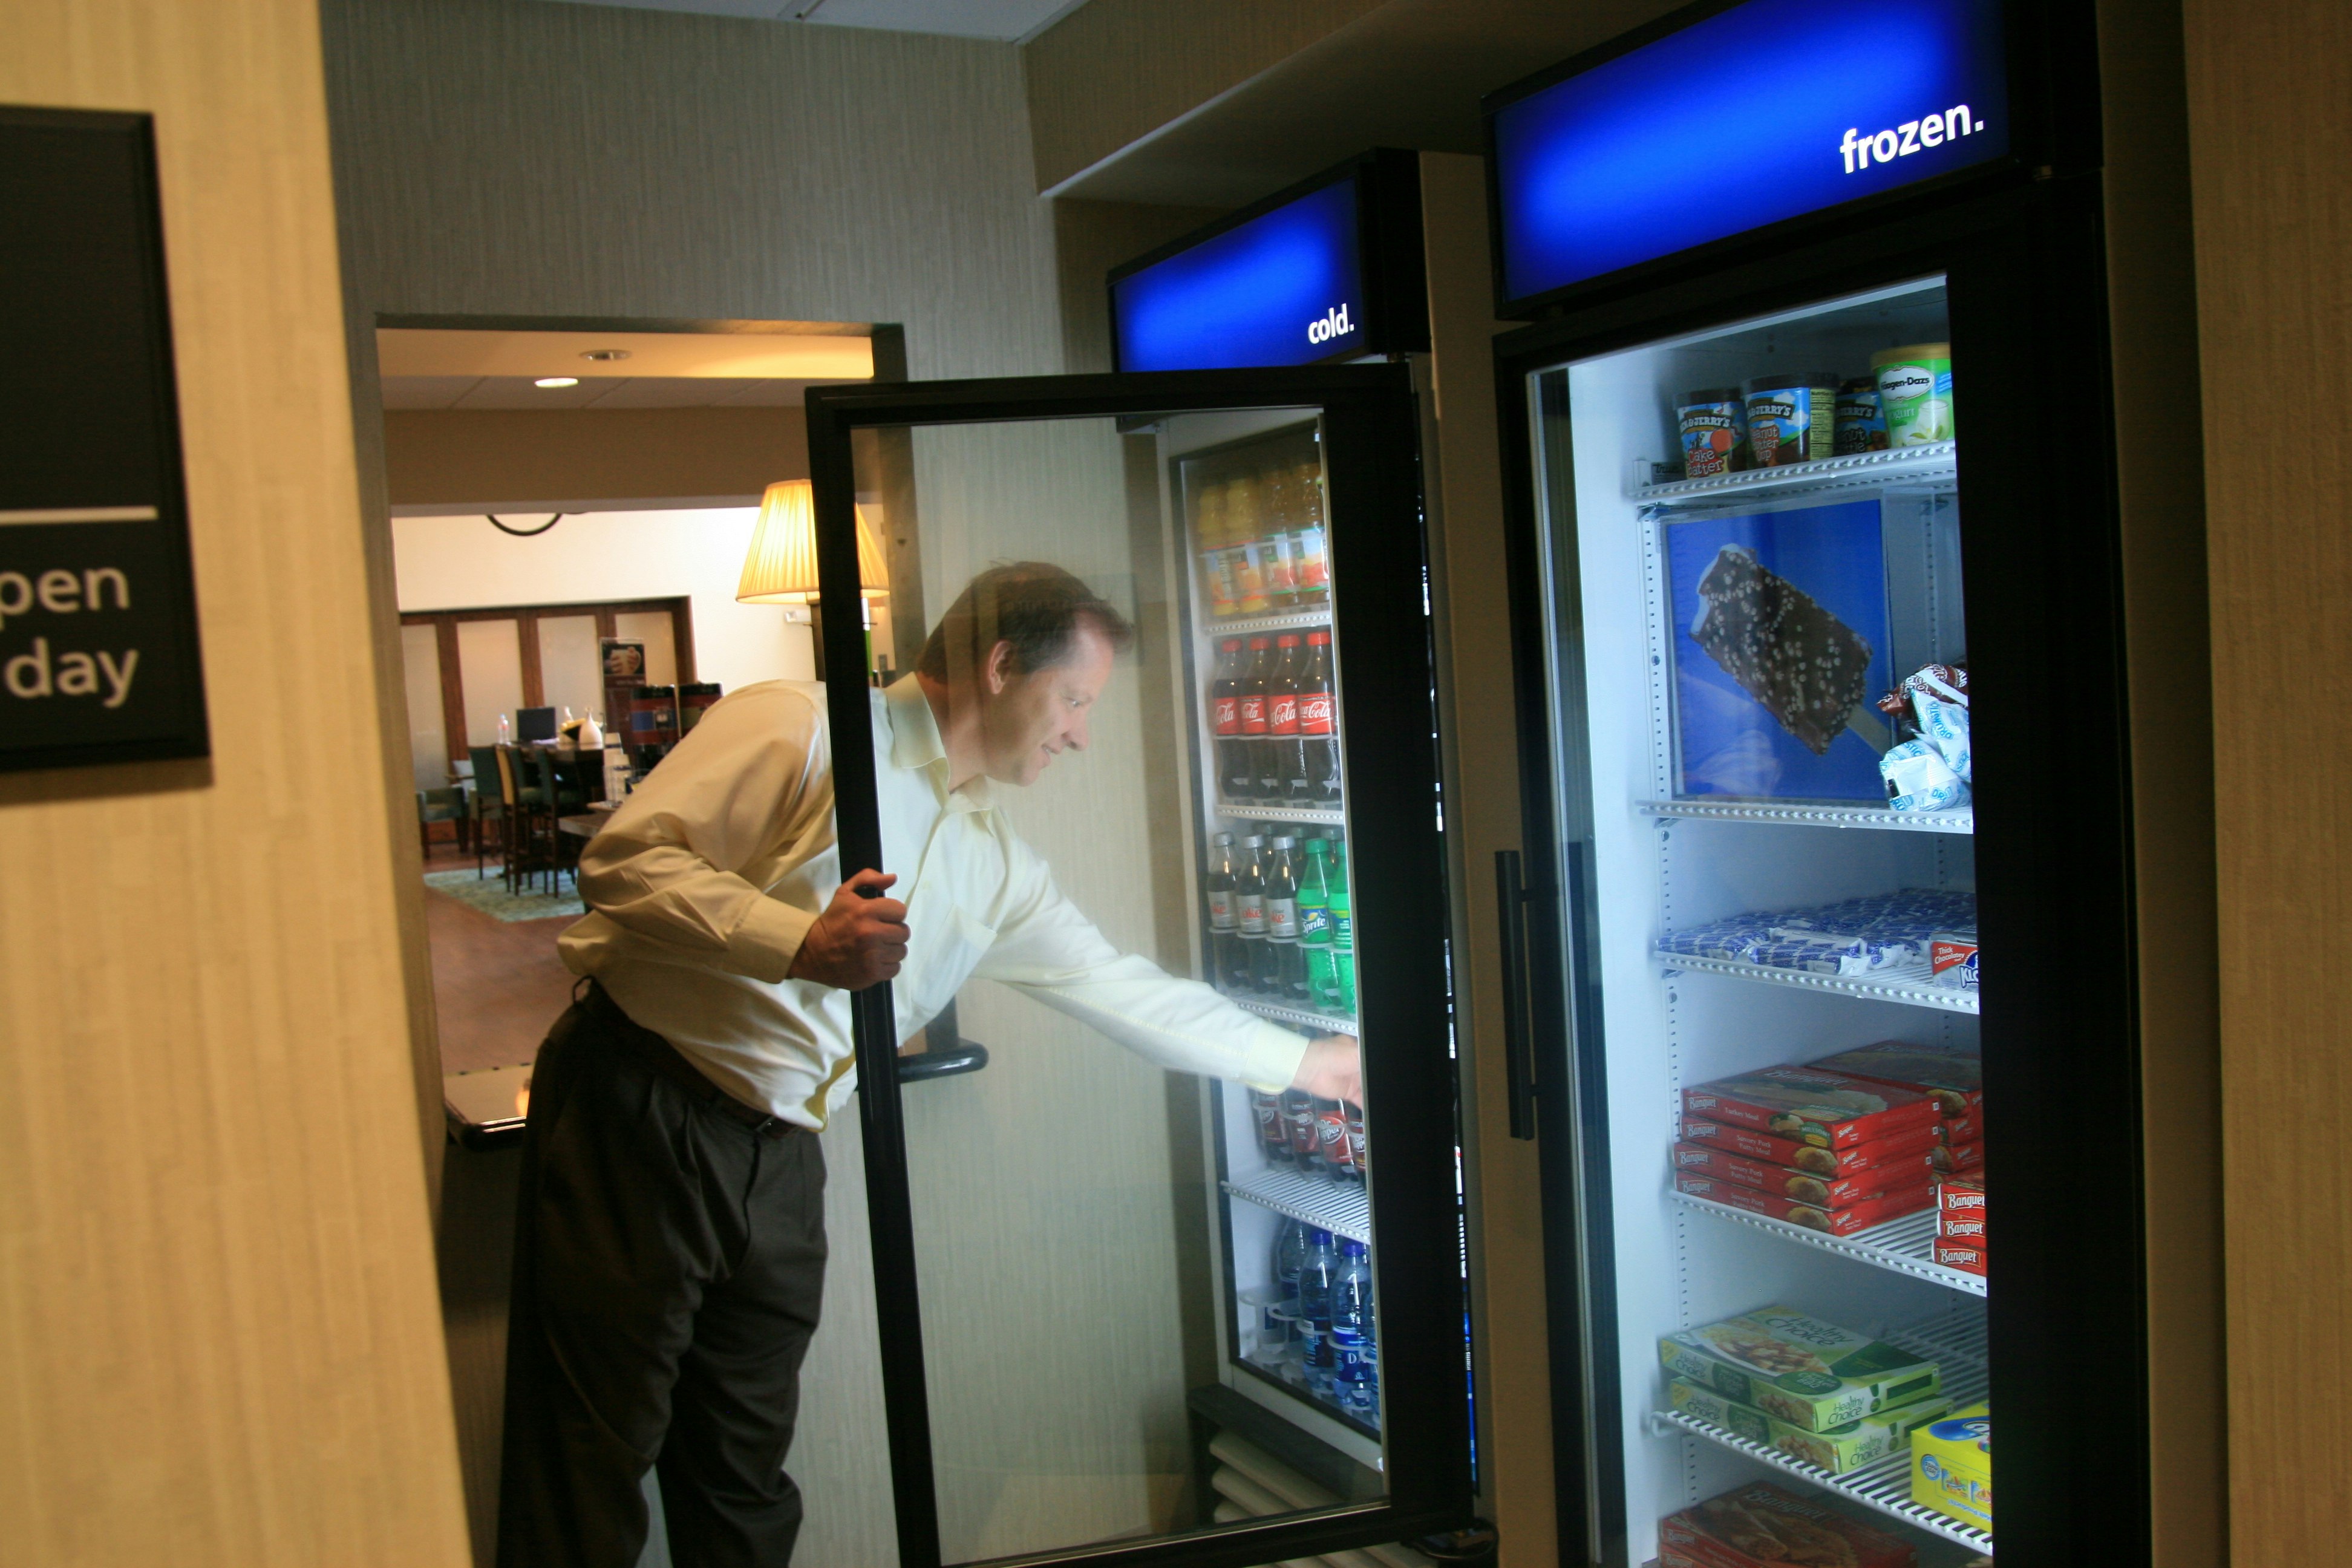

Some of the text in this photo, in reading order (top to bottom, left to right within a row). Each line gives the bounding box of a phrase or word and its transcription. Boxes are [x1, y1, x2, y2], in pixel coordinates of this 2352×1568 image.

[1840, 103, 1984, 174] frozen.
[1308, 302, 1354, 344] cold.
[4, 636, 140, 708] day
[1303, 918, 1327, 934] Sprite
[1938, 947, 1953, 955] Thick
[1688, 1097, 1716, 1110] Banquet
[1686, 1124, 1716, 1137] Banquet
[1680, 1151, 1708, 1165] Banquet
[1682, 1180, 1711, 1193] Banquet
[1946, 1221, 1983, 1236] Banquet
[1940, 1249, 1977, 1264] Banquet
[1765, 1318, 1836, 1346] Choice
[1834, 1396, 1864, 1413] Healthy
[1828, 1406, 1862, 1425] Choice
[1855, 1435, 1884, 1453] Healthy
[1851, 1446, 1882, 1466] Choice
